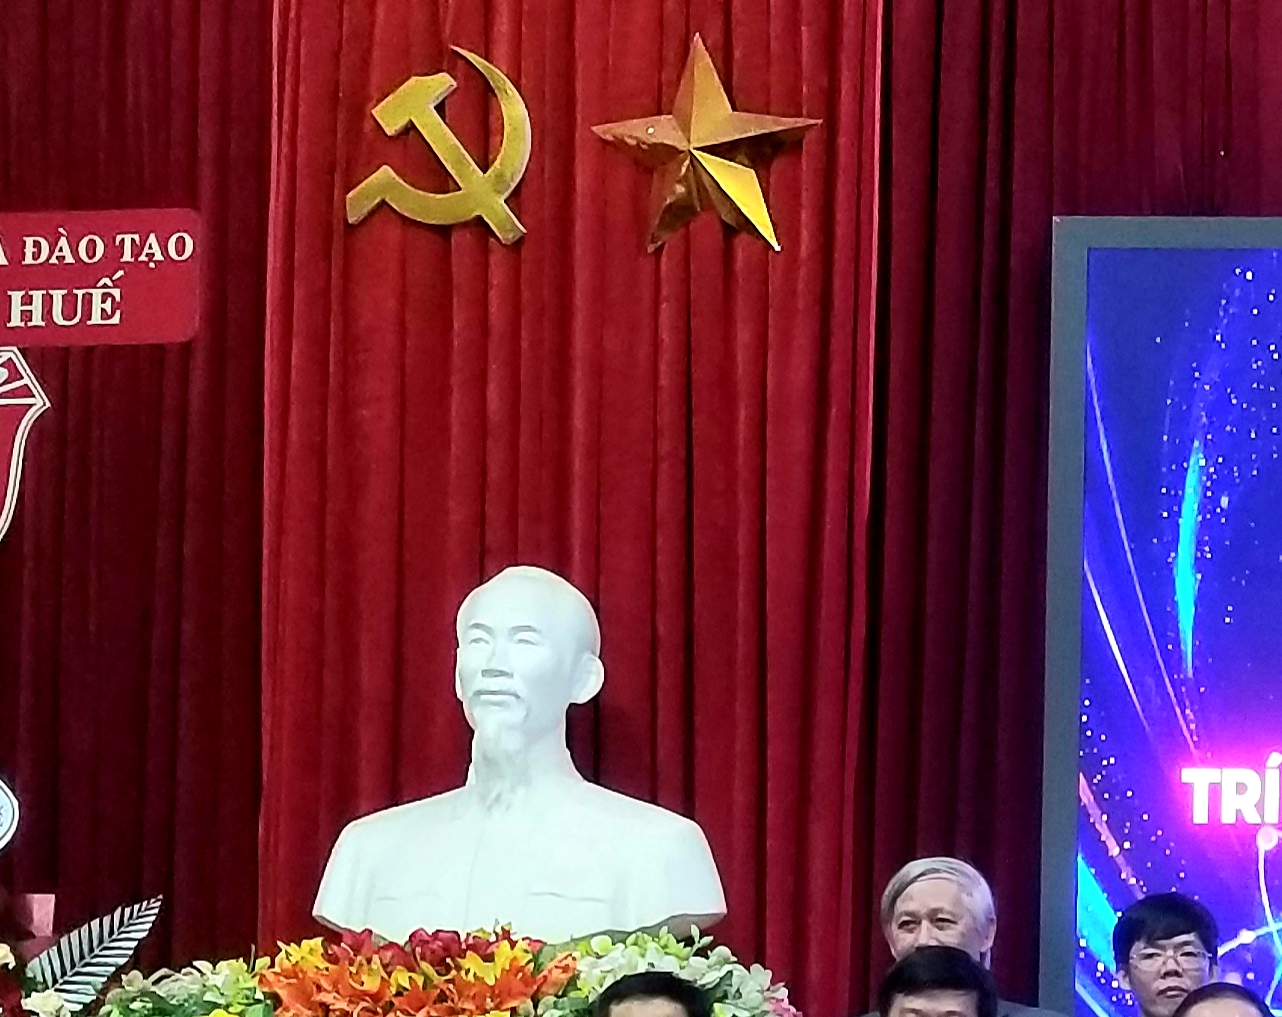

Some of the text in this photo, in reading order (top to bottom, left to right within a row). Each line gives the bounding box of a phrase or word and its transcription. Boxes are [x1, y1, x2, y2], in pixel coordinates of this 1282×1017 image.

[22, 228, 104, 265] ĐÀO
[115, 232, 194, 268] TẠO
[6, 270, 125, 328] HUẾ
